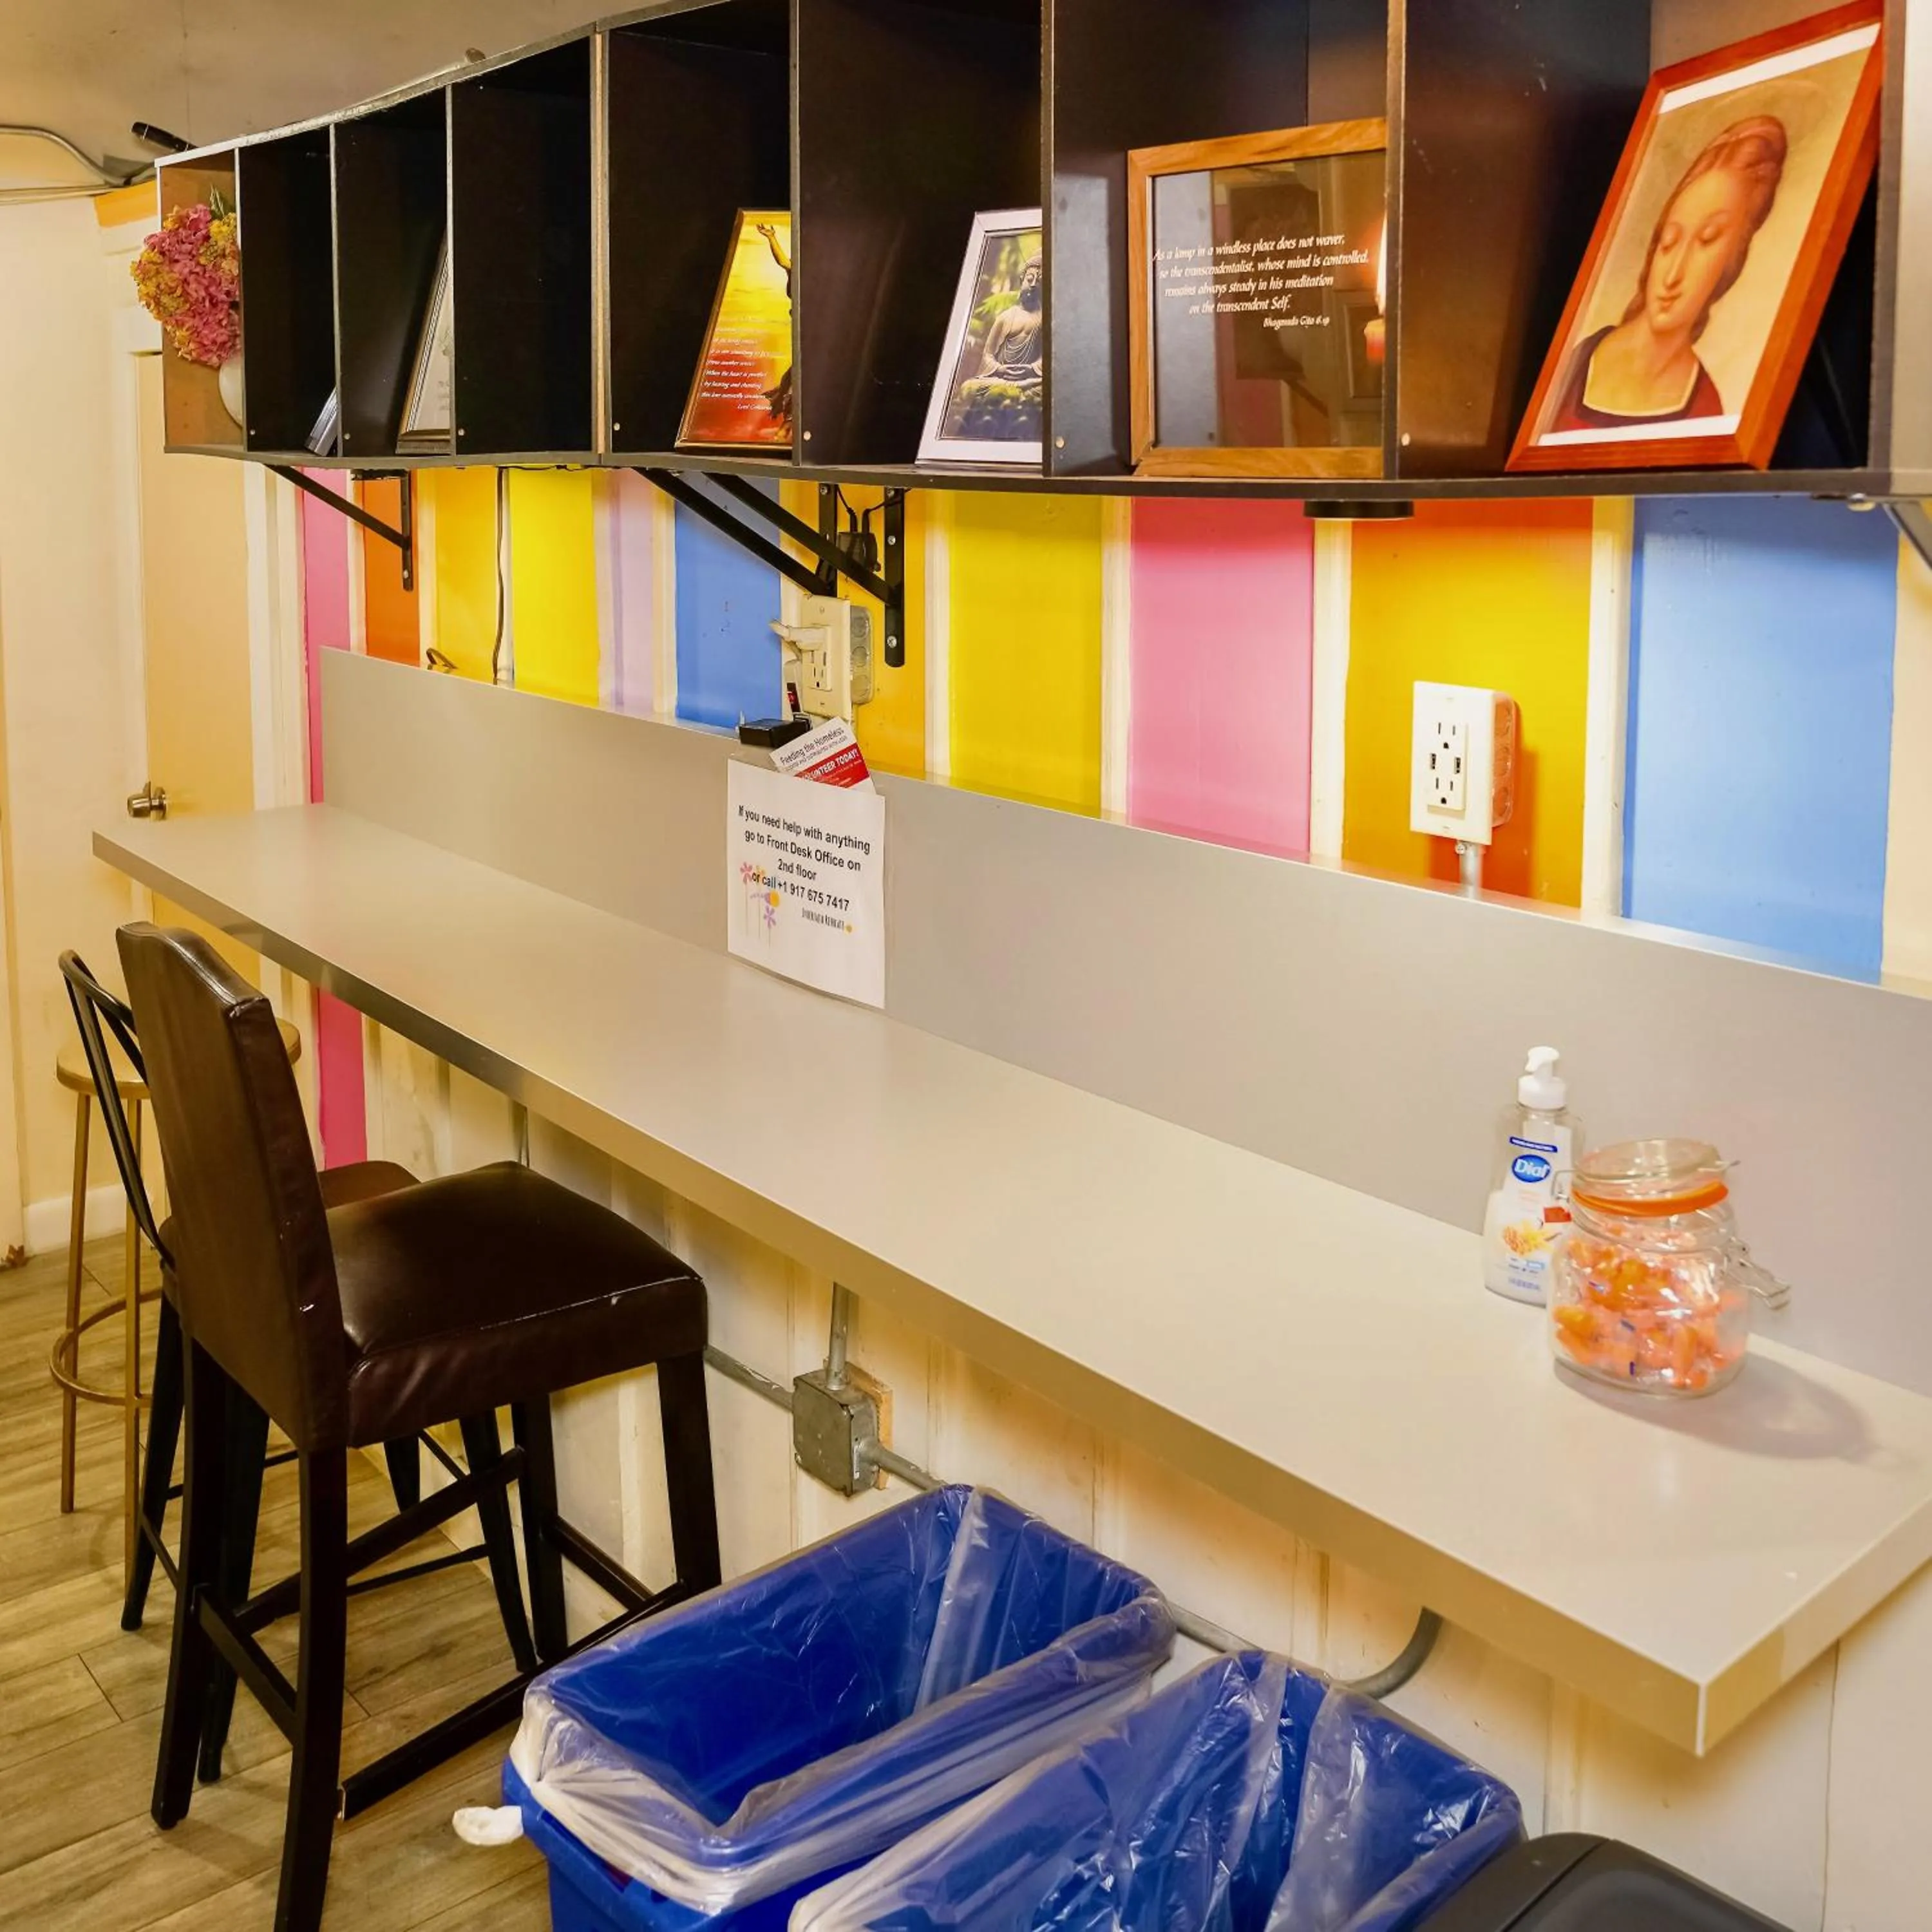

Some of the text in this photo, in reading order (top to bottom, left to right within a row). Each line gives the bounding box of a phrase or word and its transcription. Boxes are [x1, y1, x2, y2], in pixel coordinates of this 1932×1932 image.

[1215, 240, 1251, 256] windless
[1252, 238, 1276, 256] place
[1276, 236, 1296, 250] does
[1298, 236, 1314, 248] not
[1258, 257, 1284, 271] whose
[1287, 254, 1311, 269] mind
[1312, 254, 1320, 267] is
[1198, 282, 1227, 298] always
[1228, 278, 1256, 296] steady
[1258, 278, 1267, 290] in
[1269, 276, 1283, 290] his
[1285, 274, 1334, 289] meditation
[1201, 300, 1215, 314] the
[1217, 298, 1269, 312] transcendent
[780, 748, 806, 765] Feeding
[804, 742, 815, 753] the
[813, 727, 845, 746] Homeless
[837, 748, 860, 766] TODAY!
[739, 805, 871, 855] If you need help with anything
[745, 830, 861, 871] go to Front Desk Office on
[778, 858, 817, 880] 2nd floor
[752, 872, 849, 912] or call +1 917 675 7417
[1514, 1157, 1550, 1178] Dial
